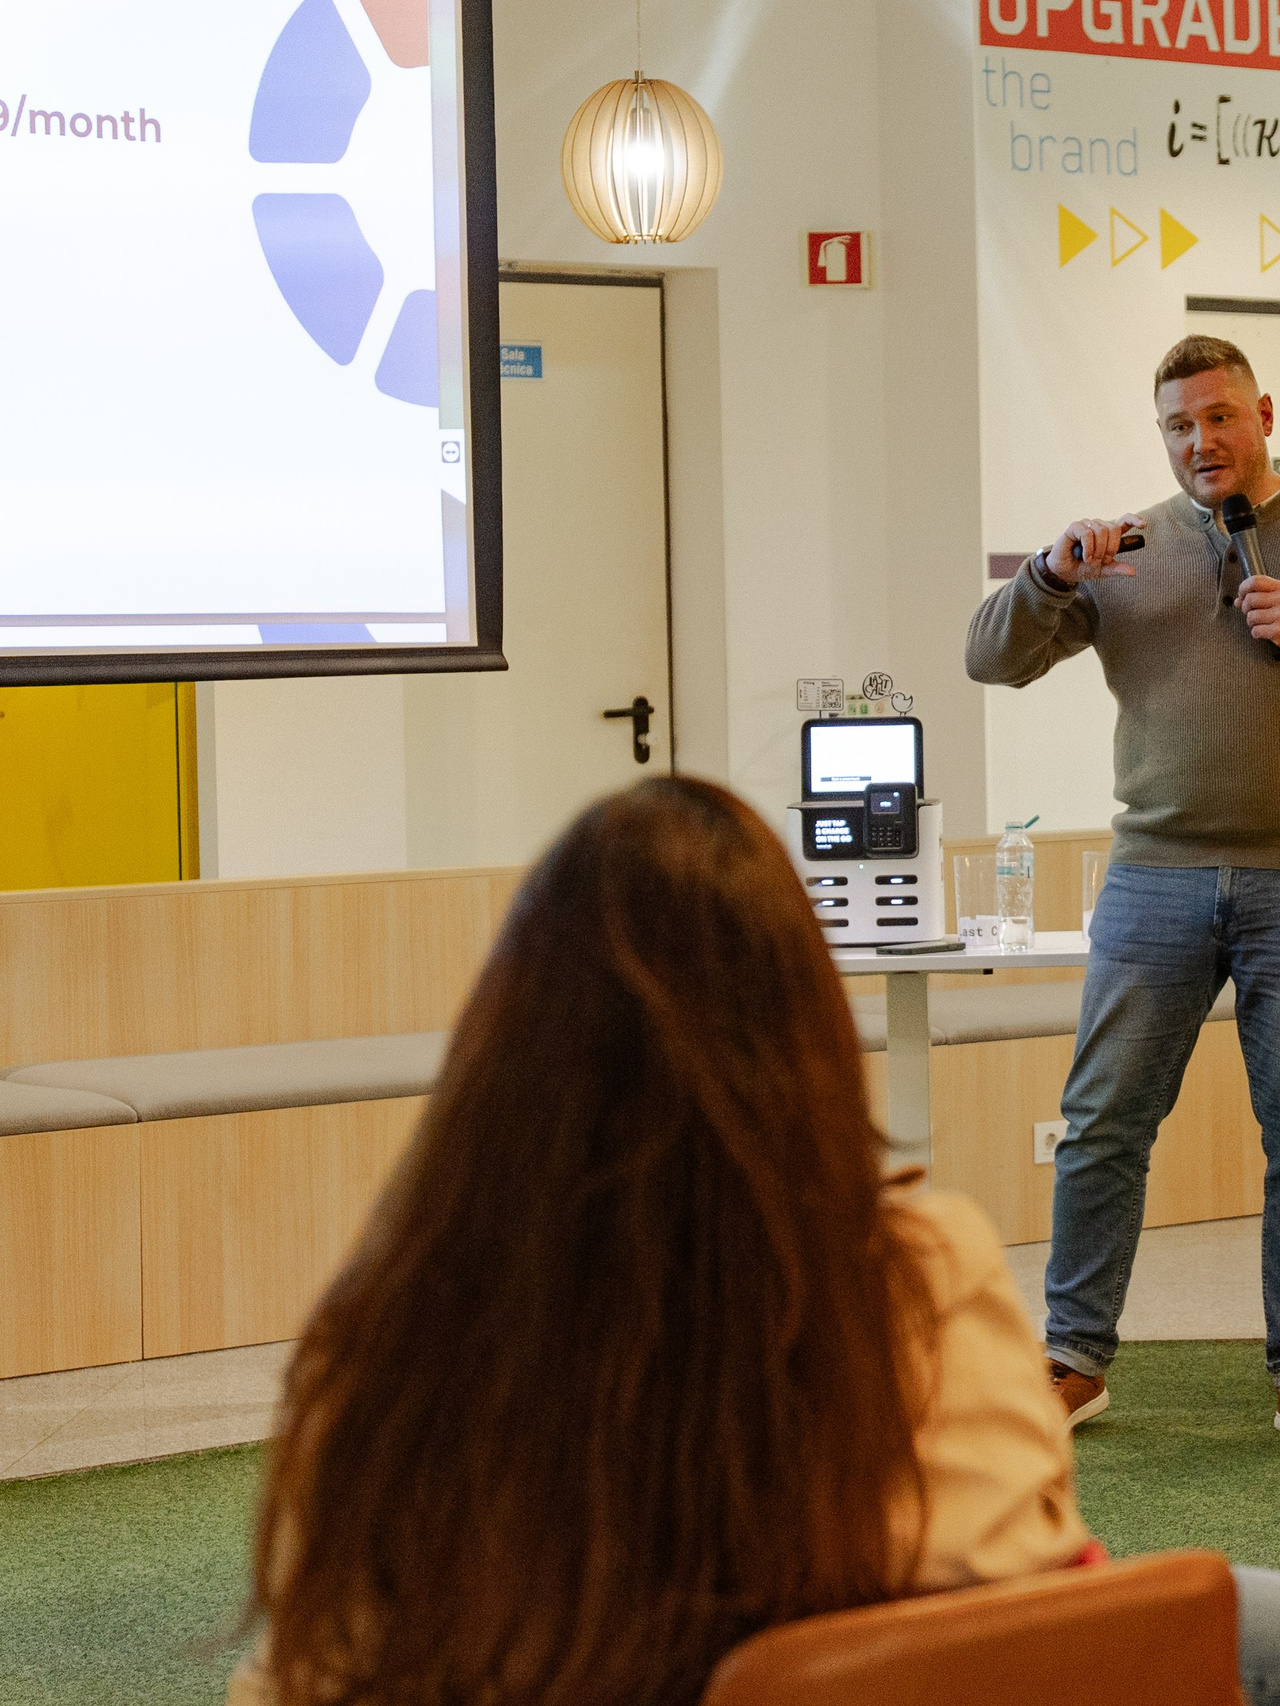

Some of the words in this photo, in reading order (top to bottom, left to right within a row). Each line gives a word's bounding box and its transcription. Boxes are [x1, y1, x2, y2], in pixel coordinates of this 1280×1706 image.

[982, 56, 1052, 110] the
[1010, 121, 1138, 176] brand
[501, 347, 525, 361] Sala
[960, 926, 983, 937] ast
